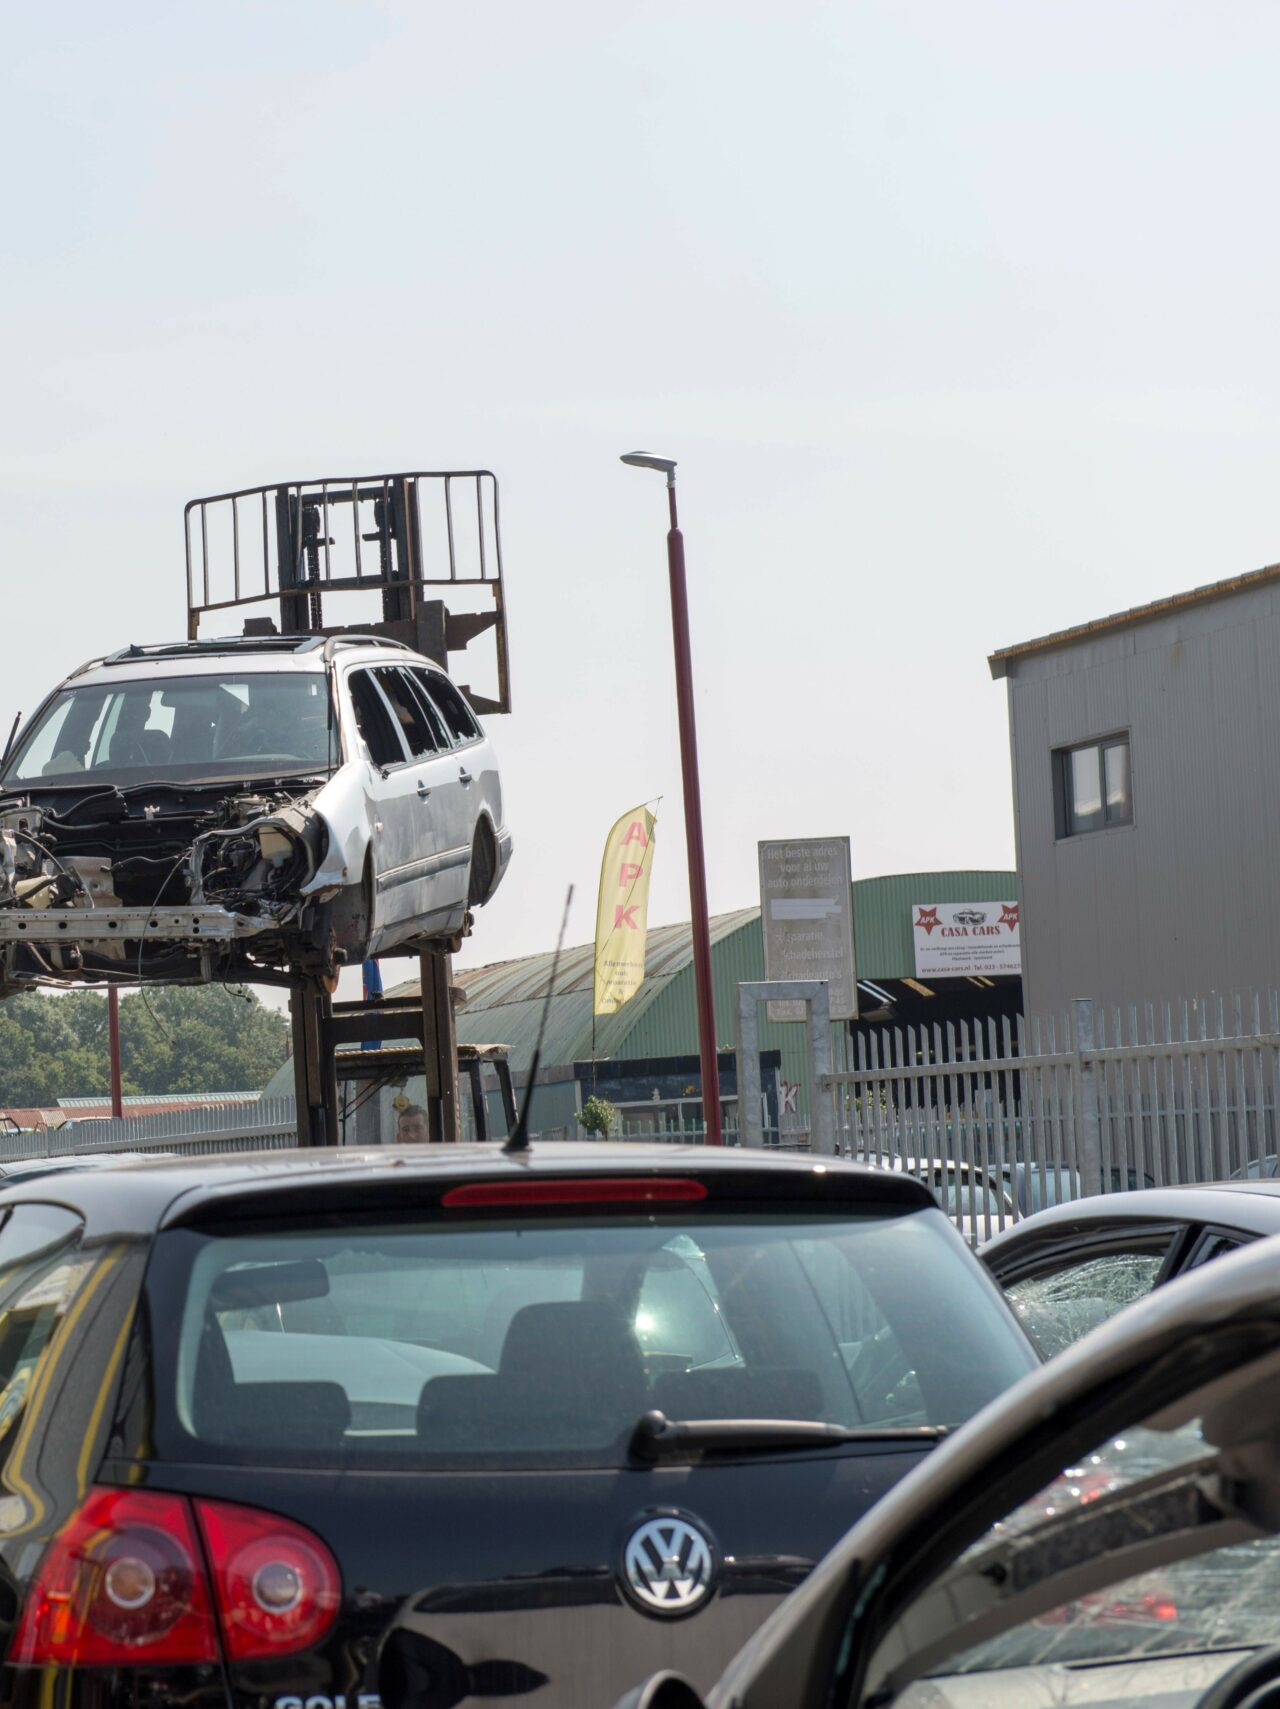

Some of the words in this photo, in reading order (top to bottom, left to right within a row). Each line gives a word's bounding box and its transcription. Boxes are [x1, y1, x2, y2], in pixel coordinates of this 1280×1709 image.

[785, 847, 810, 858] beste
[812, 845, 838, 857] adres
[779, 862, 800, 873] voor
[613, 821, 648, 930] APK
[767, 879, 789, 889] auto
[940, 926, 969, 937] CASA
[972, 925, 1001, 936] CARS
